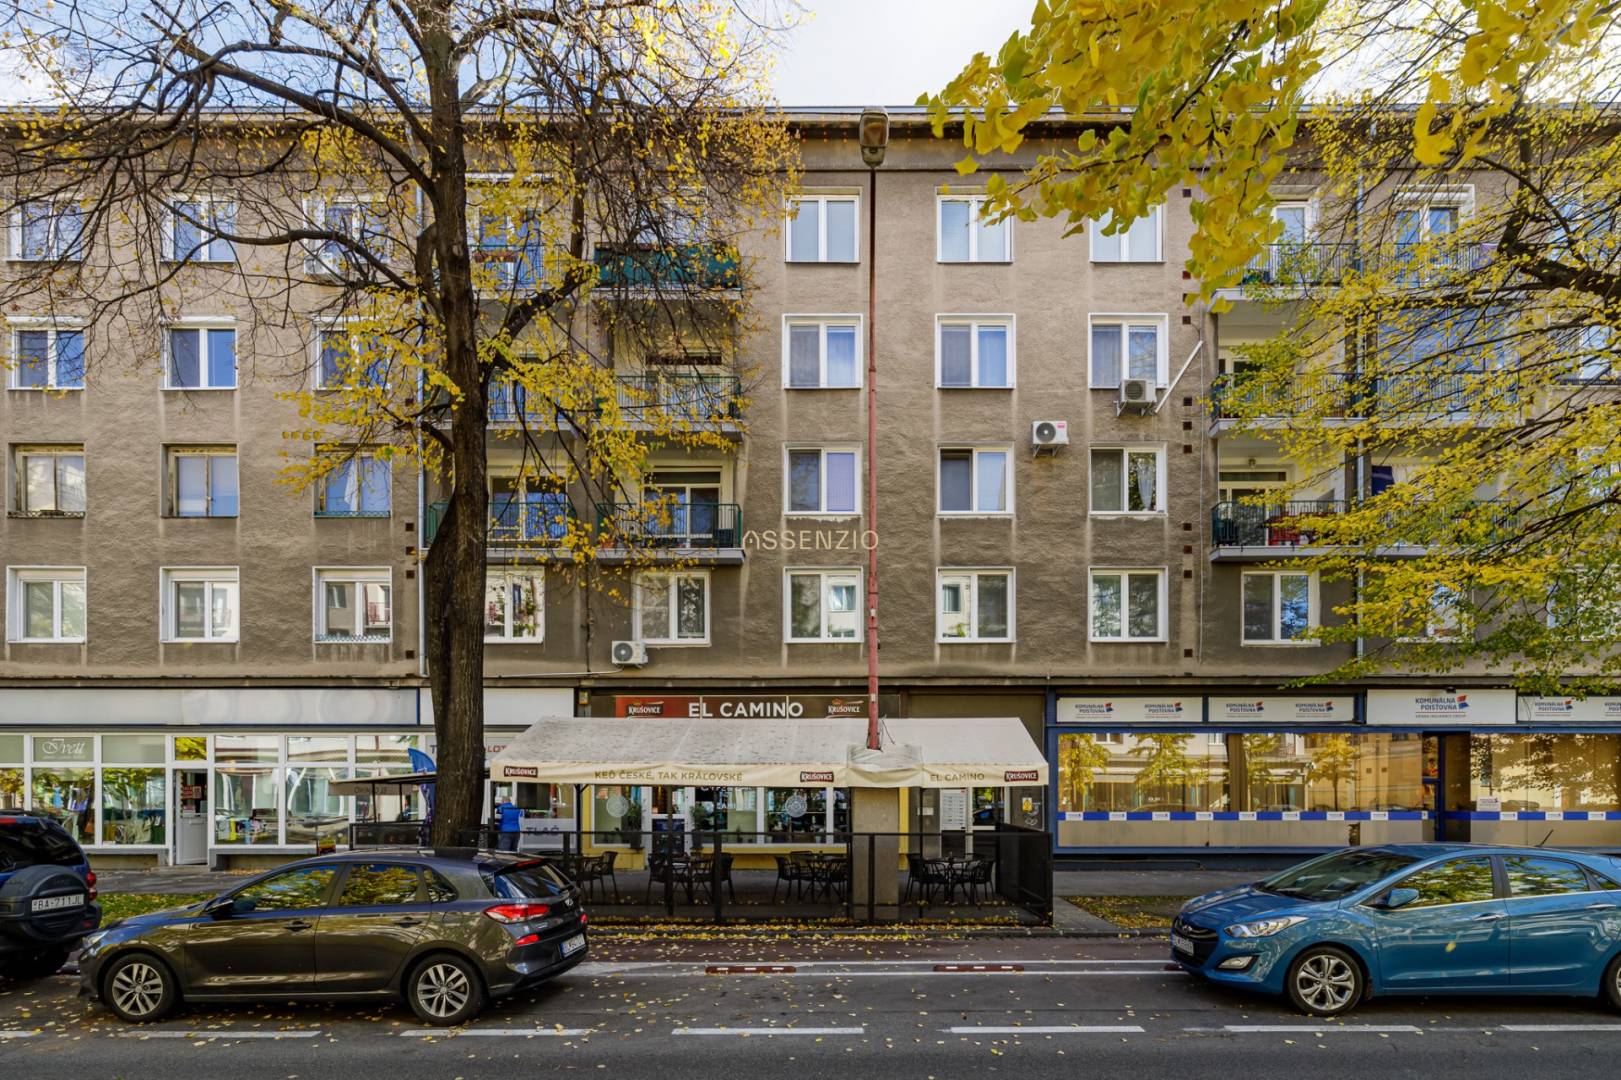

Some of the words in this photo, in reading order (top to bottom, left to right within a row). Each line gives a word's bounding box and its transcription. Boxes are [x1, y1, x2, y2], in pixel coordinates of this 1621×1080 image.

[688, 702, 713, 717] EL
[719, 702, 804, 717] CAMINO
[658, 771, 678, 780] TAK
[930, 774, 942, 782] EL
[944, 773, 985, 782] CAMINO
